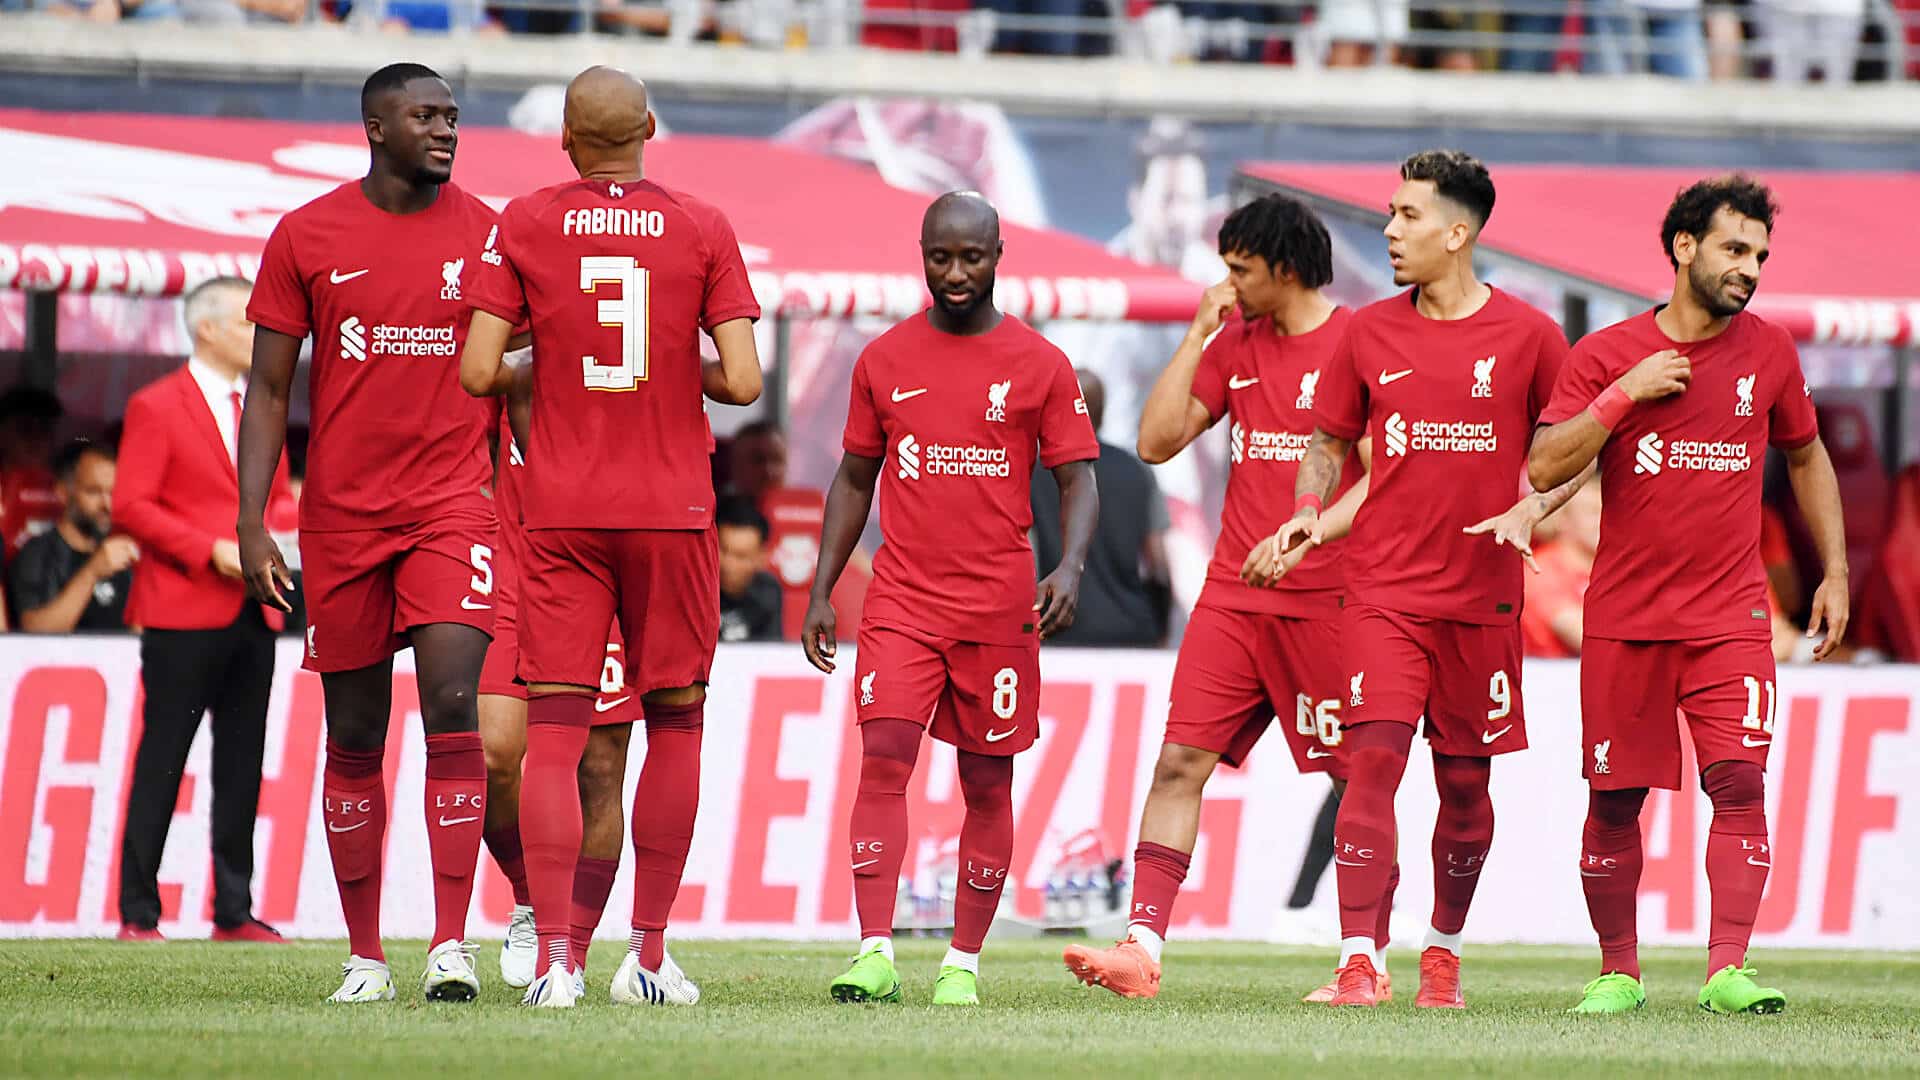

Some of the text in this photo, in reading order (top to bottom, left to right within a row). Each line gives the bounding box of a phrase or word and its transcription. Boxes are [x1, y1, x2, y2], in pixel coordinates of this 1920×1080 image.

[563, 208, 665, 237] FABINHO
[440, 288, 463, 300] LFC
[371, 323, 454, 341] standard
[580, 256, 650, 392] 3
[370, 340, 457, 356] chartered
[1470, 383, 1493, 398] LFC
[985, 407, 1007, 422] LFC
[1734, 403, 1754, 417] LFC
[1411, 419, 1494, 438] standard
[925, 442, 1007, 462] standard
[1411, 435, 1498, 453] chartered
[1670, 438, 1748, 458] standard
[925, 459, 1011, 477] chartered
[1667, 455, 1751, 473] chartered
[469, 543, 494, 597] 5
[991, 667, 1019, 720] 8
[1488, 669, 1512, 721] 9
[1742, 676, 1776, 735] 11
[1296, 692, 1343, 747] 66
[850, 841, 884, 854] FC
[1581, 853, 1617, 869] FC
[1134, 901, 1159, 916] FC
